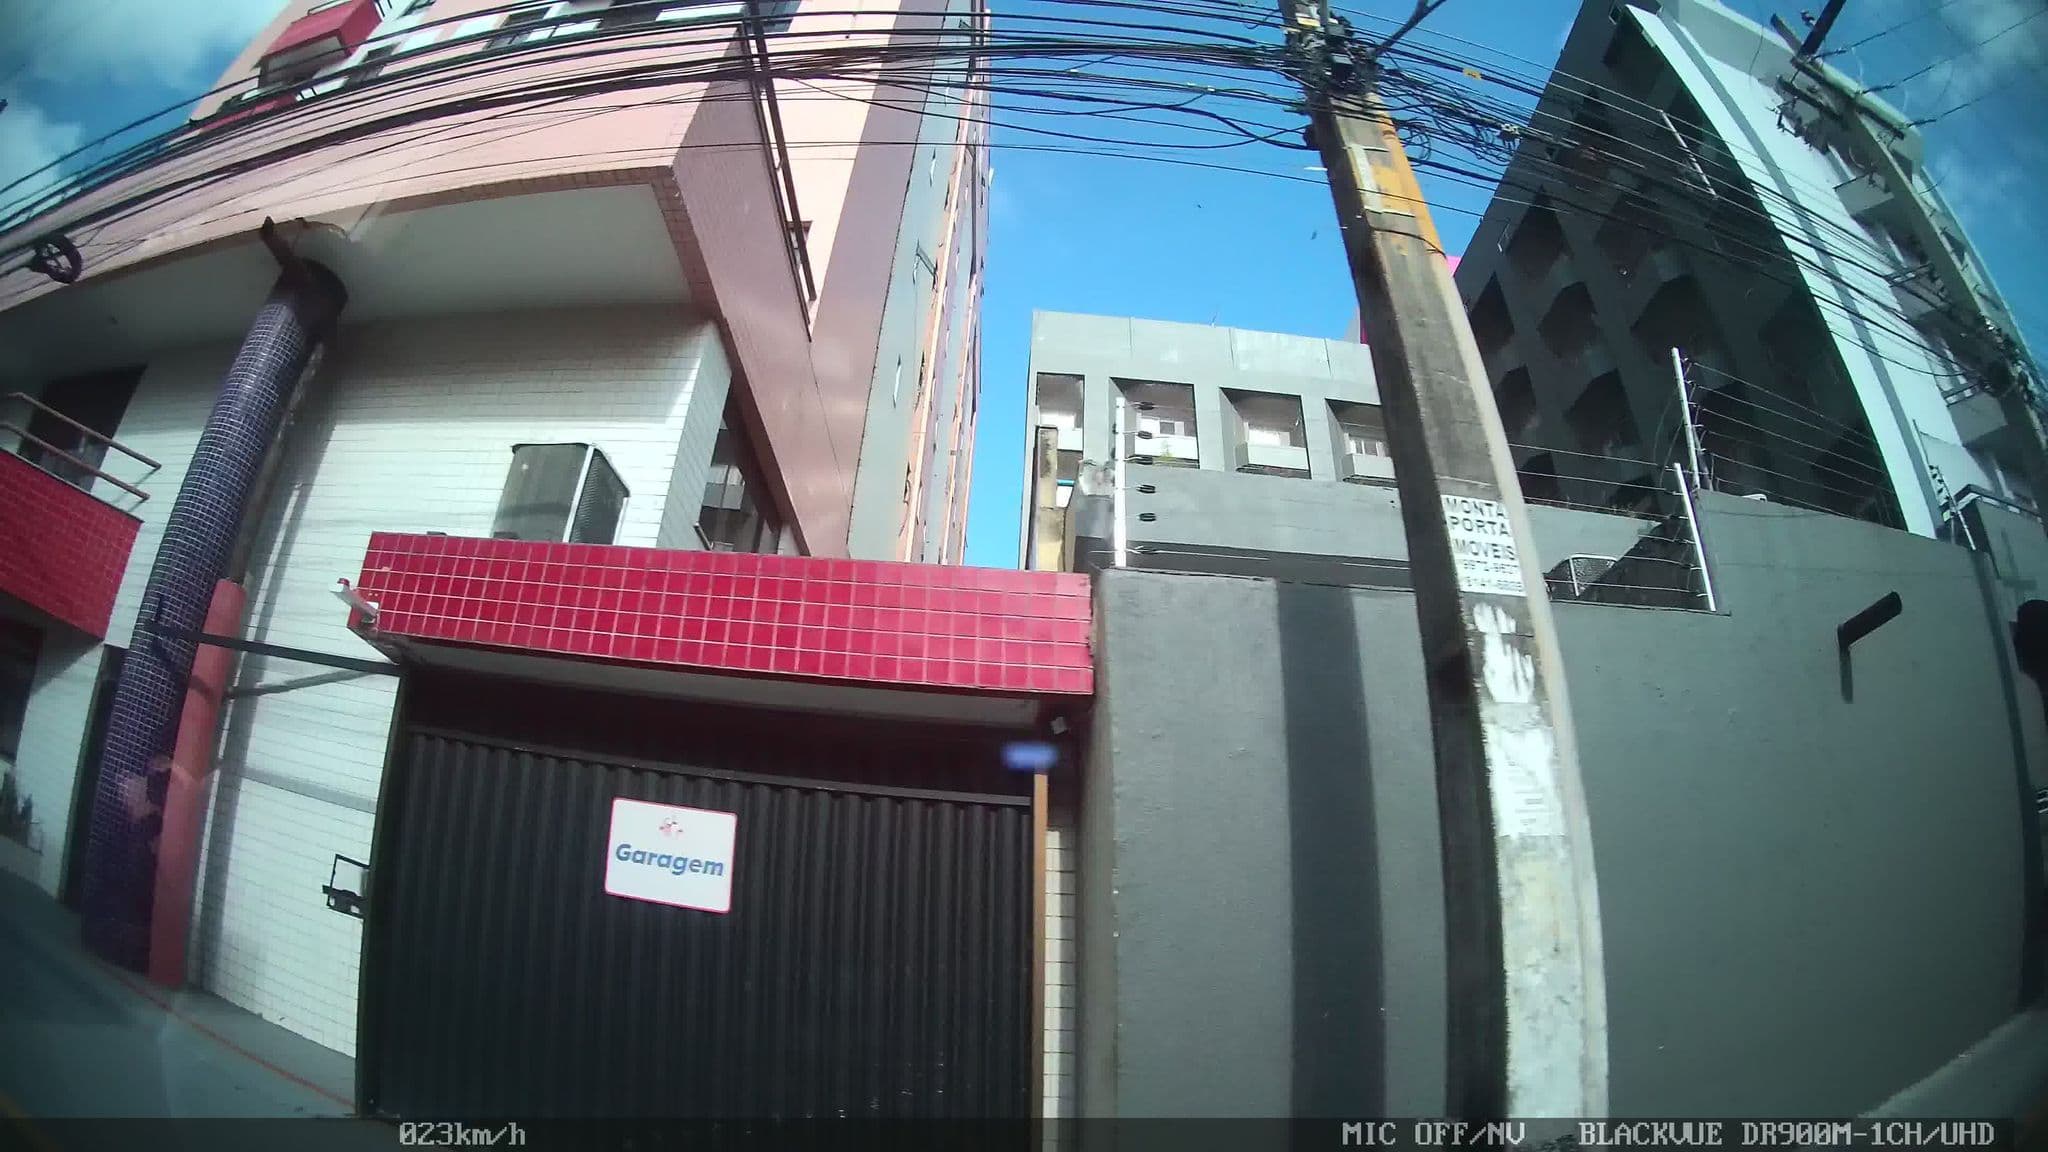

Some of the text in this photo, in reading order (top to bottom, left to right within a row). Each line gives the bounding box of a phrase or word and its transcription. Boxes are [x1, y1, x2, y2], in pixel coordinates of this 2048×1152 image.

[1446, 497, 1506, 518] MONTA
[1449, 515, 1511, 536] PORTA
[616, 843, 724, 876] Garagem
